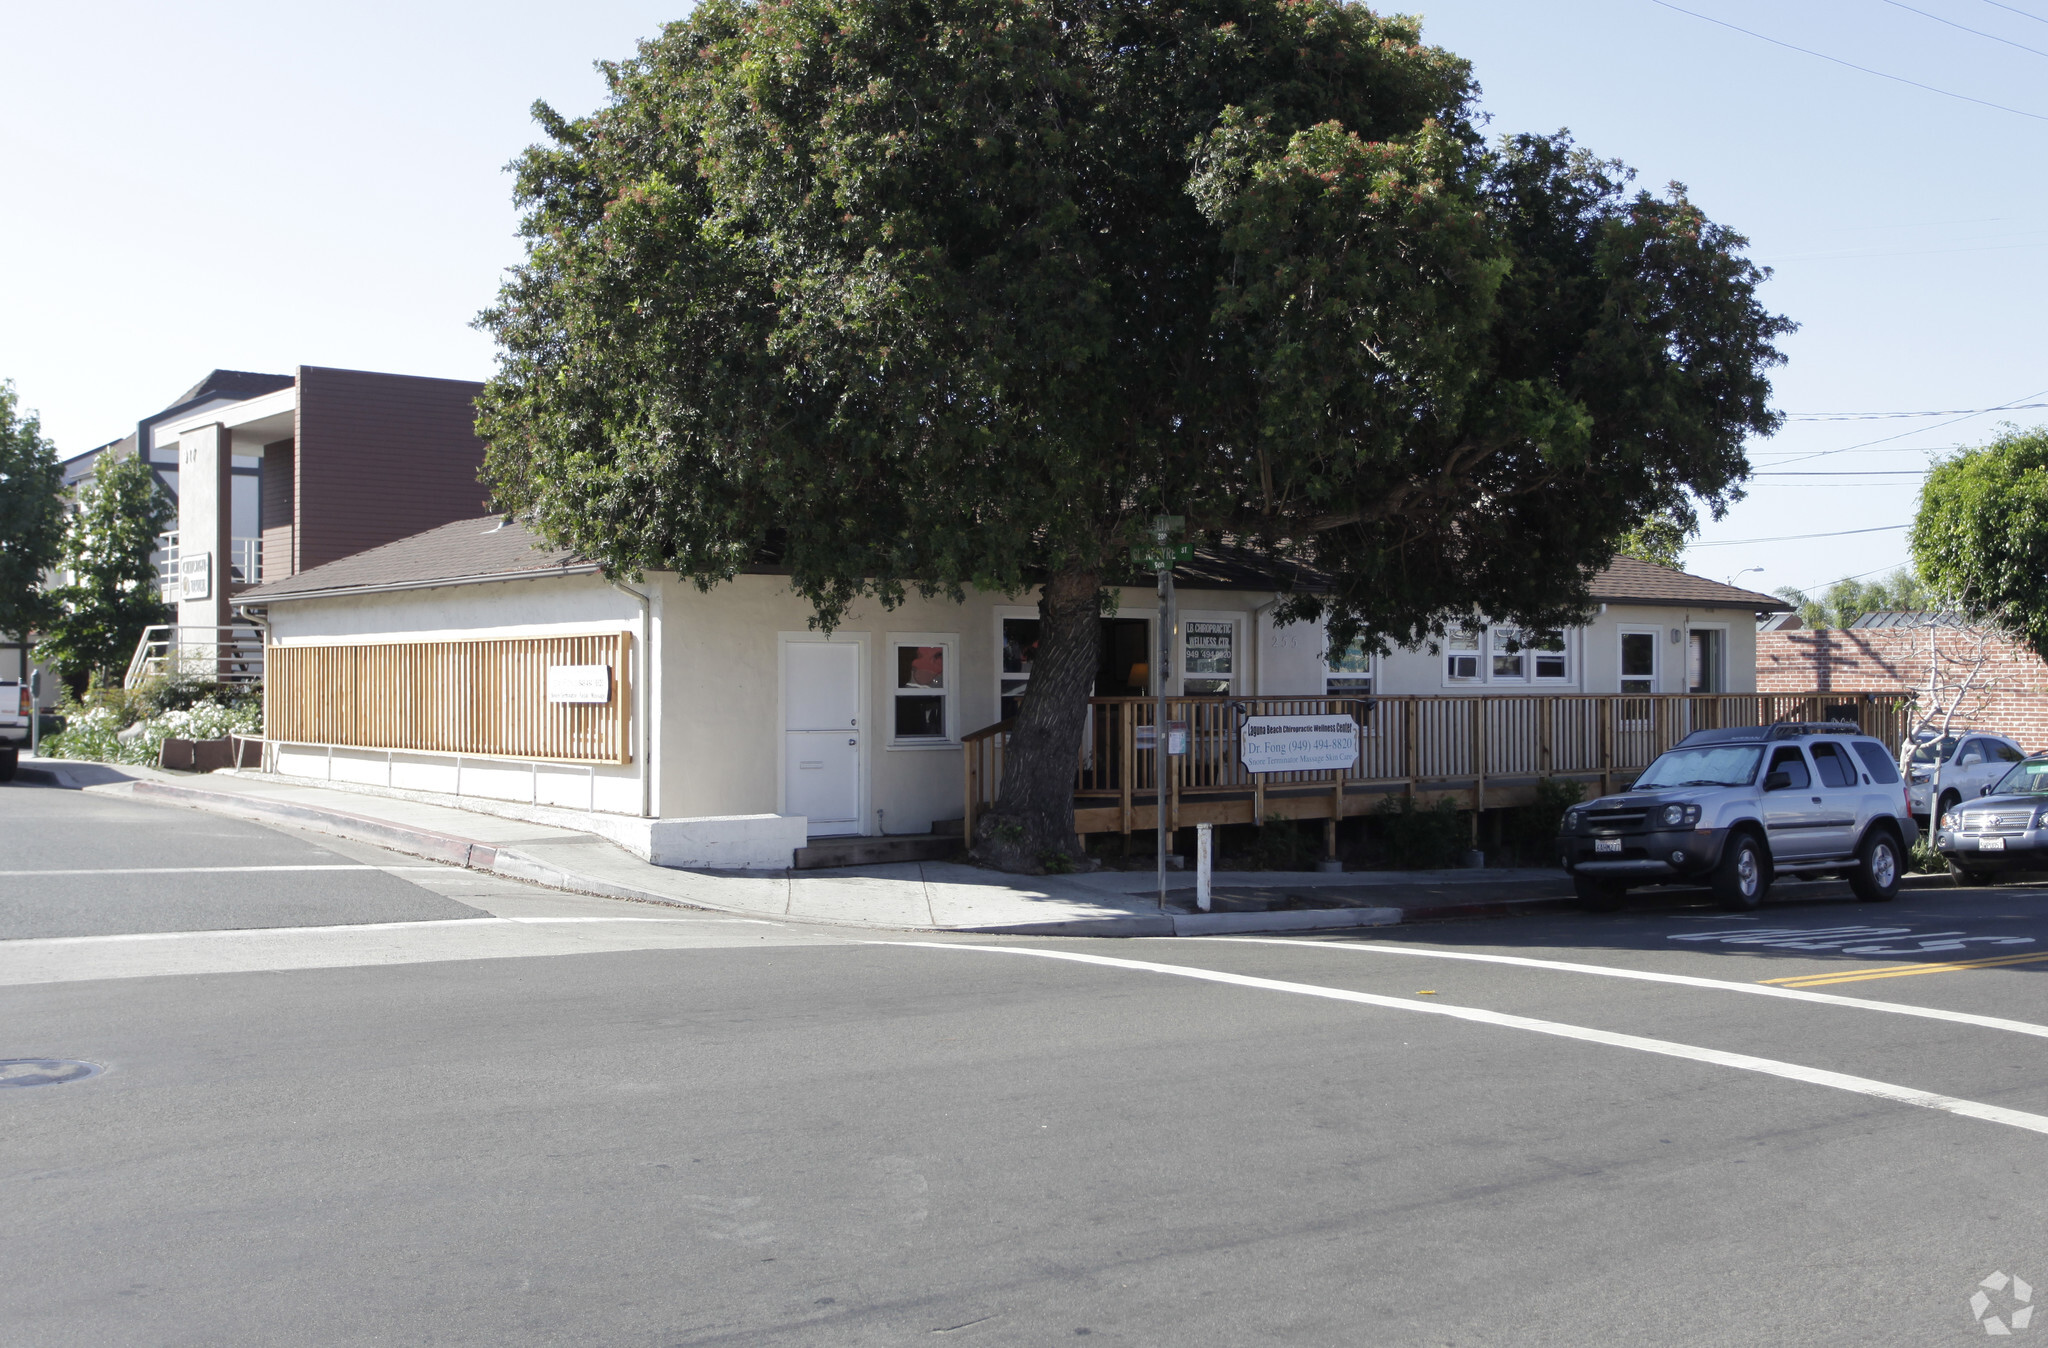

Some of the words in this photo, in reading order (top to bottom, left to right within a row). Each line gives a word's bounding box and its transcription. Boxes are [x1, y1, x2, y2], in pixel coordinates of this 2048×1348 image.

[1180, 546, 1188, 554] ST
[1187, 623, 1194, 633] LB
[1195, 623, 1232, 634] CHIROPRACTIC
[1189, 636, 1217, 646] WELLNESS
[1272, 636, 1297, 648] 255
[1186, 650, 1199, 658] 949
[1248, 723, 1266, 737] Laguna
[1267, 724, 1282, 734] Beach
[1283, 724, 1313, 733] Chiropractic
[1314, 724, 1335, 732] Wellness
[1336, 722, 1352, 733] Center
[1248, 742, 1262, 754] Dr.
[1264, 741, 1286, 755] Fong
[1288, 740, 1311, 752] (949)
[1313, 738, 1352, 750] 494-8820
[1248, 757, 1265, 766] Snore
[1267, 757, 1298, 765] Terminator
[1300, 755, 1324, 764] Massage
[1325, 753, 1338, 761] Skin
